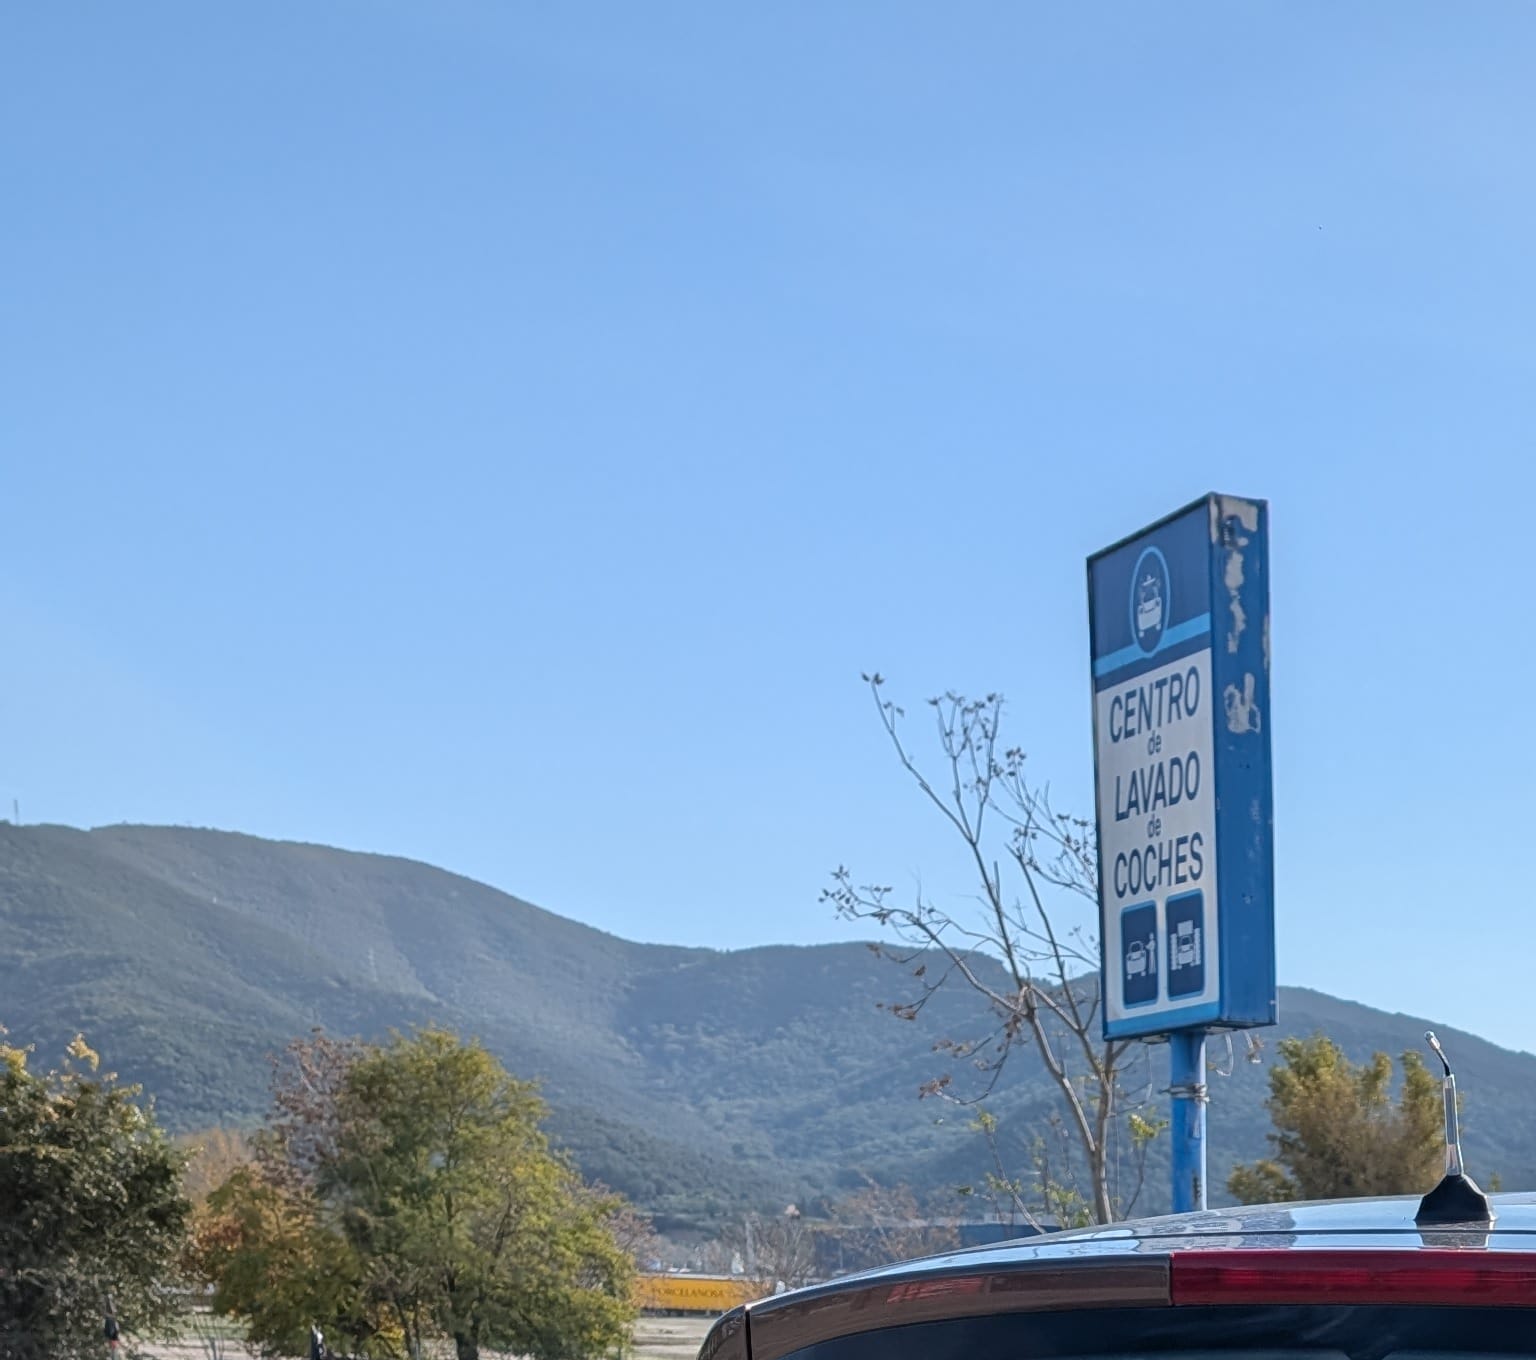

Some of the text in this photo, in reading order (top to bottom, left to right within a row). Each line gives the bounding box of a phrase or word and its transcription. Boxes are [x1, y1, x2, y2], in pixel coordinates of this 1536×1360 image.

[1109, 666, 1200, 743] CENTRO
[1147, 731, 1162, 755] de
[1115, 751, 1200, 821] LAVADO
[1147, 813, 1162, 838] de
[1113, 832, 1204, 898] COCHES
